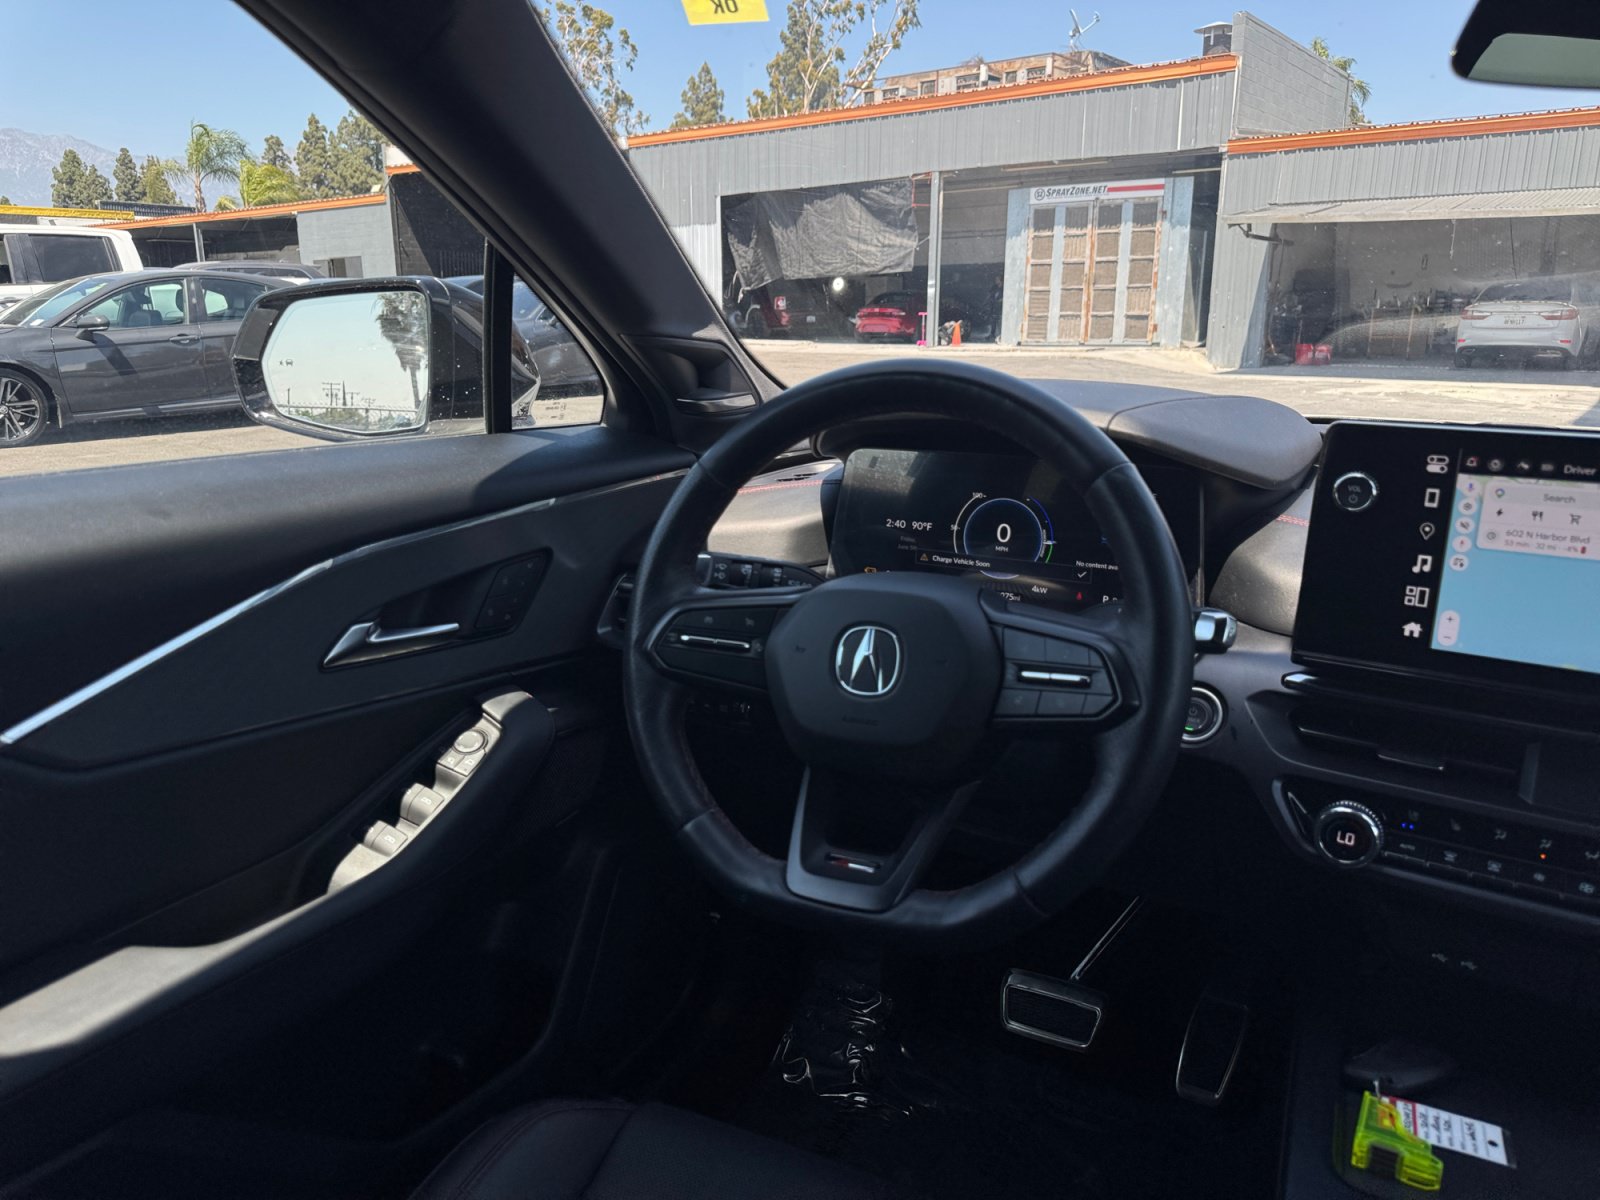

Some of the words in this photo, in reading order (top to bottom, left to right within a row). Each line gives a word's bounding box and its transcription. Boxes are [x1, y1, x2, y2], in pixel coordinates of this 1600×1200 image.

[1563, 464, 1597, 476] Driver
[1543, 493, 1576, 504] Search
[886, 518, 906, 529] 2:40
[912, 521, 933, 531] 90°F
[996, 523, 1012, 543] 0
[1505, 529, 1524, 538] 602
[1536, 532, 1568, 542] Harbor
[1570, 536, 1591, 544] Blvd
[932, 555, 952, 564] Charge
[953, 557, 974, 566] Vehicle
[975, 560, 990, 568] Soon
[1031, 585, 1048, 594] 4kW
[1102, 595, 1109, 604] P
